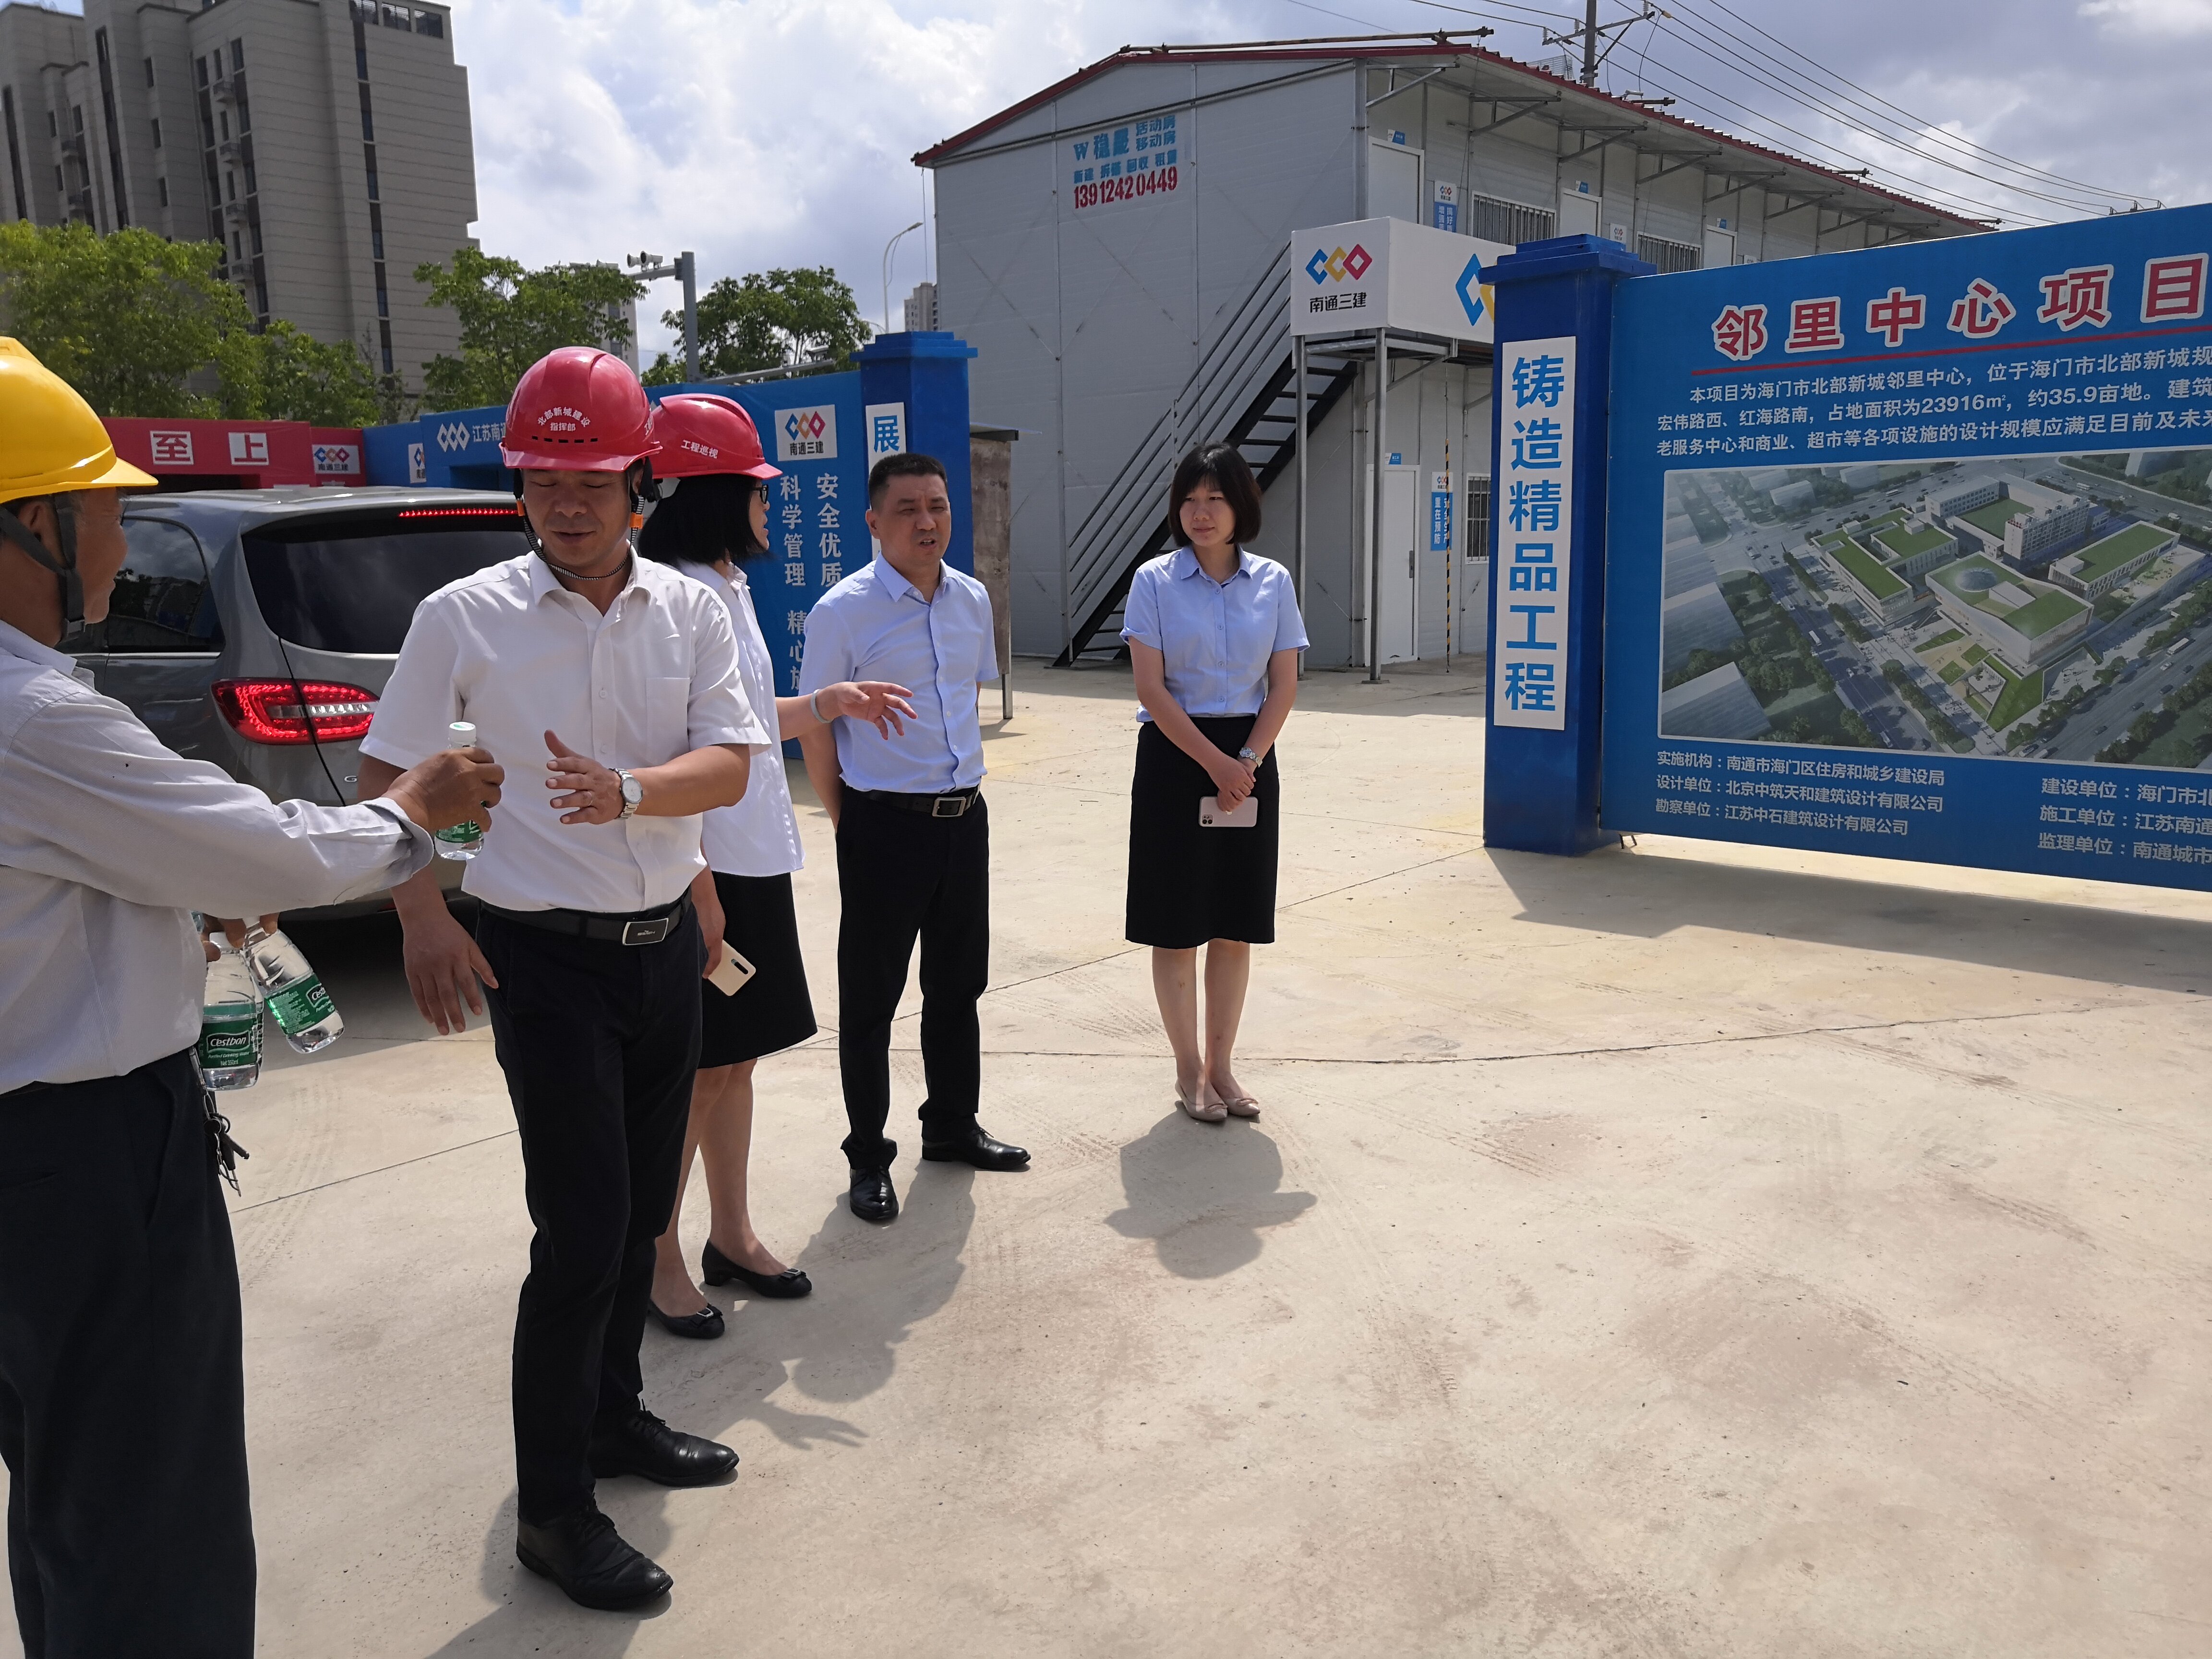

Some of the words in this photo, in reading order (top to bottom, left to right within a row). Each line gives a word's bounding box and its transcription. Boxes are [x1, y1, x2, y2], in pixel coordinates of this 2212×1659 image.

[1074, 166, 1178, 209] 13912420449
[1310, 292, 1367, 313] 南通三建
[1712, 252, 2210, 361] 邻里中心项目
[538, 407, 591, 427] 北部新城建设
[551, 422, 576, 432] 指挥部
[874, 415, 900, 453] 展
[681, 439, 719, 459] 工程巡视
[790, 441, 824, 456] 南通三建
[780, 474, 806, 587] 科学管理
[817, 472, 842, 588] 安全优质
[1504, 355, 1565, 712] 铸造精品工程
